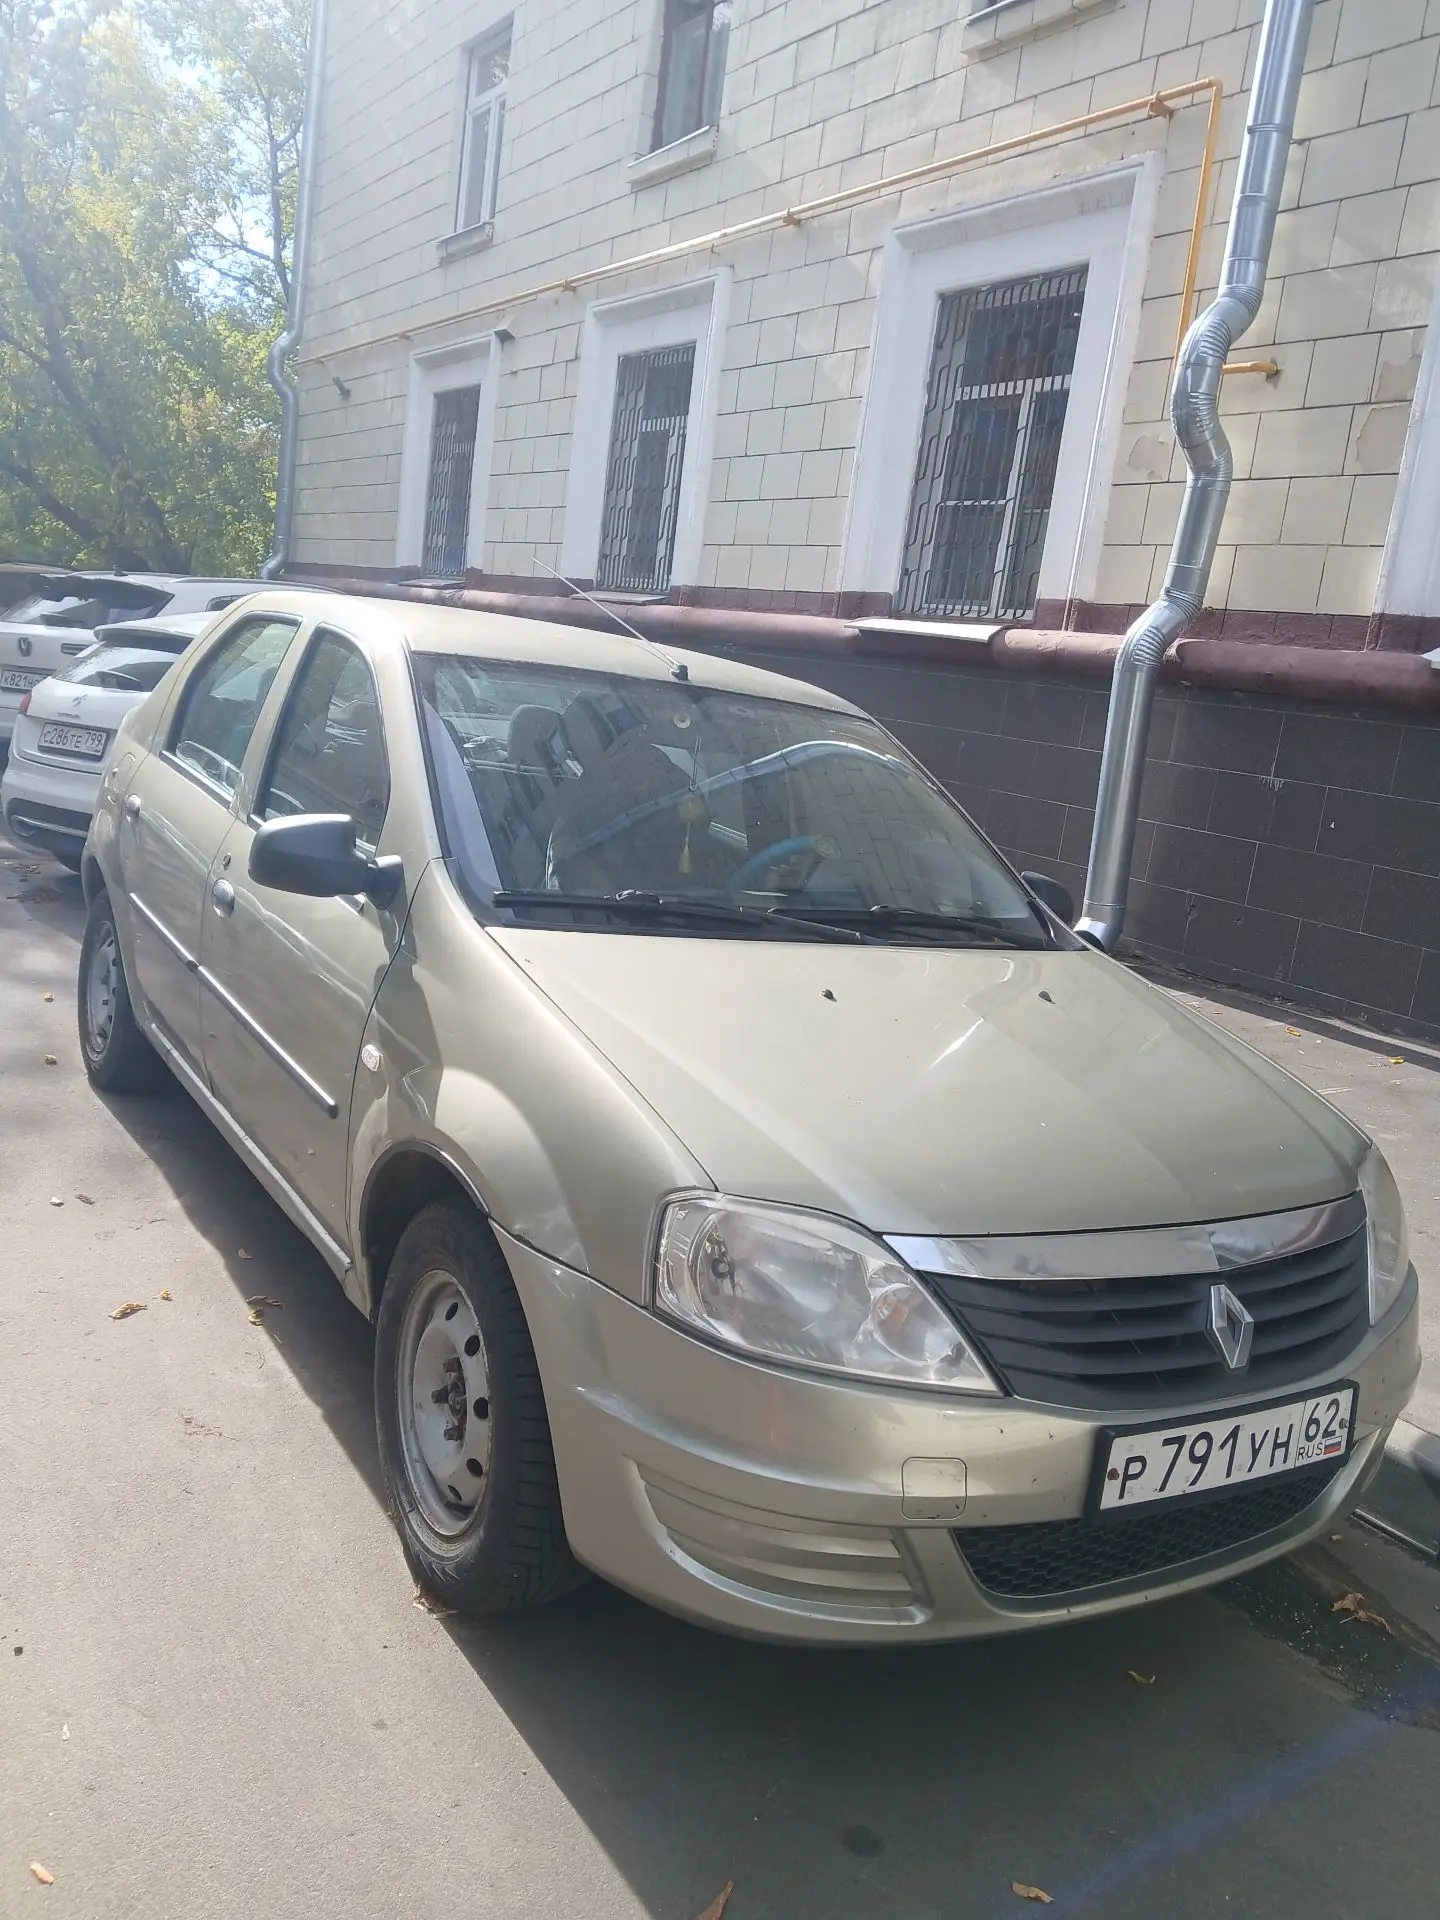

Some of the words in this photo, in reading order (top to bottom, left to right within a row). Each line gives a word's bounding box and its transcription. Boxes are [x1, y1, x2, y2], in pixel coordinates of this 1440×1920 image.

[84, 732, 102, 747] 799
[1304, 1398, 1340, 1443] 62
[1297, 1445, 1323, 1462] RUS
